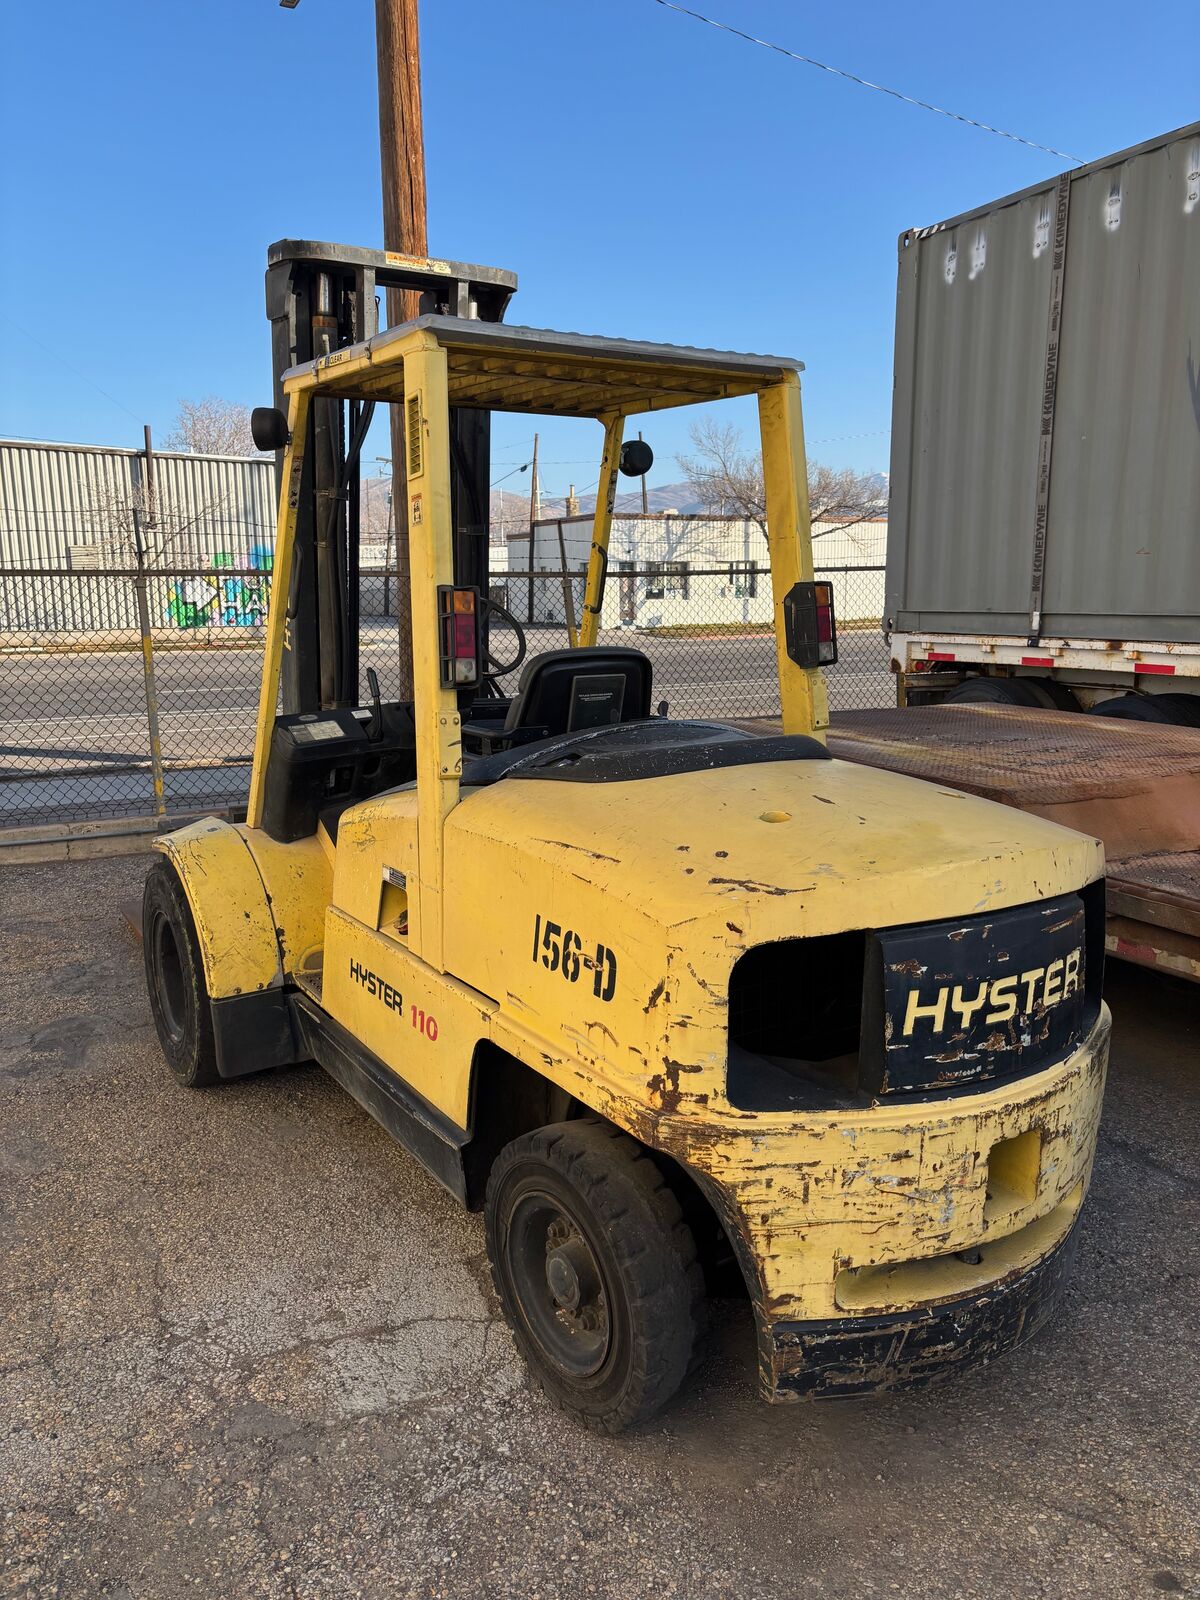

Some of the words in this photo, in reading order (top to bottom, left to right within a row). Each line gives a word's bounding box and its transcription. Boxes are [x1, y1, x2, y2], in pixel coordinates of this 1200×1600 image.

[1055, 173, 1069, 249] KINEDYNE
[1043, 343, 1057, 415] KINEDYNE
[1033, 504, 1046, 572] KINEDYNE
[349, 958, 403, 1017] HYSTER
[410, 1004, 439, 1042] 110
[903, 946, 1082, 1036] HYSTER
